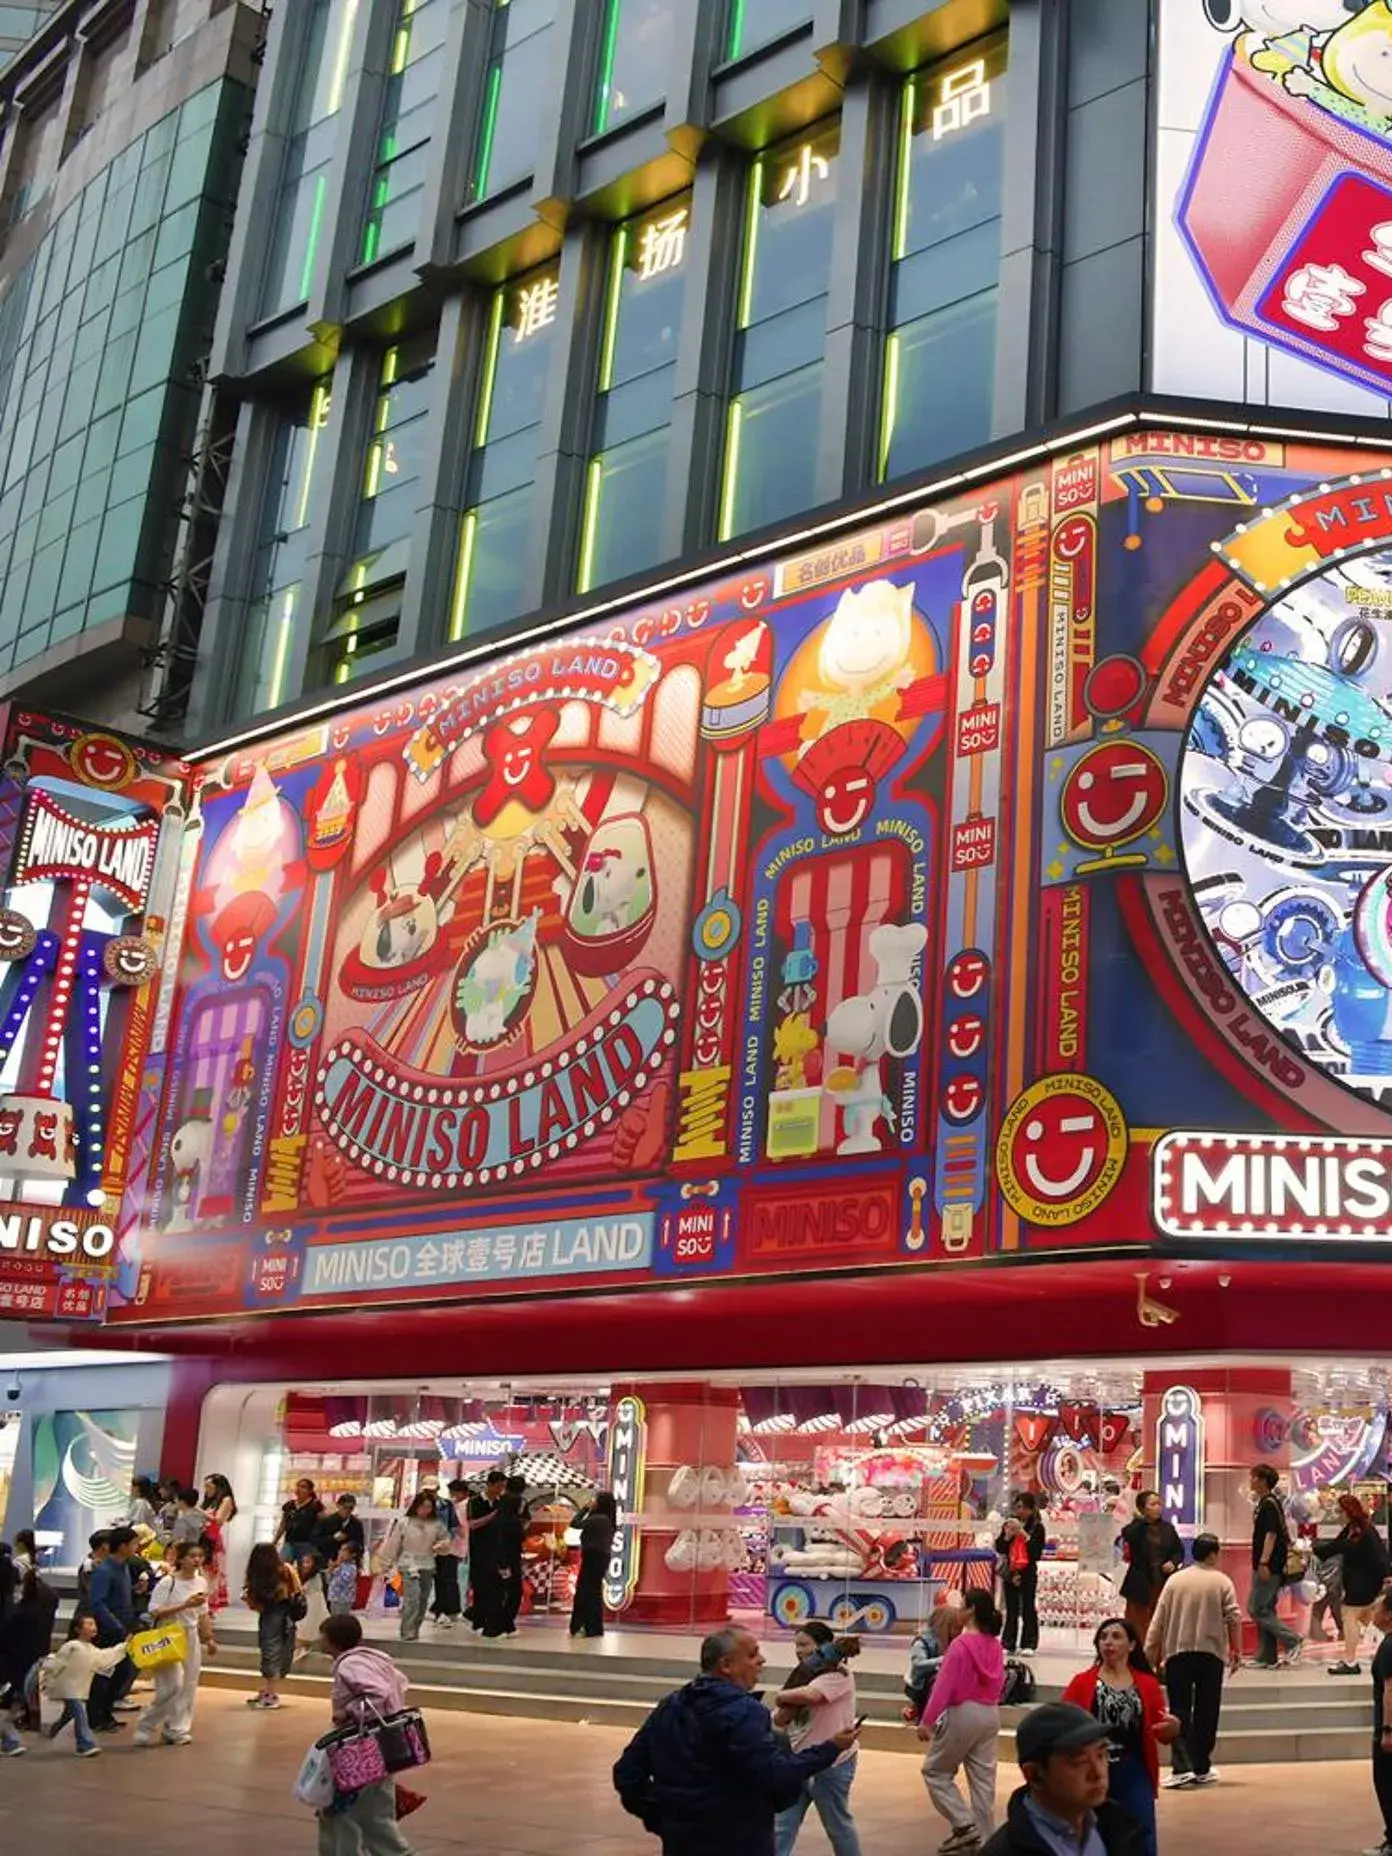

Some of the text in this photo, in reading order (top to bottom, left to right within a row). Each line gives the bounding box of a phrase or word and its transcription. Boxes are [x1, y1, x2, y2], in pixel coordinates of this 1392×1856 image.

[1057, 466, 1094, 486] MINI
[1125, 433, 1266, 461] MINISO
[1053, 611, 1066, 737] MINISO LAND
[1162, 601, 1243, 709] MINISO
[438, 655, 622, 736] MINISO LAND
[961, 711, 997, 731] MINI
[1232, 667, 1382, 761] MINISO
[28, 806, 150, 892] MINISO LAND
[765, 838, 815, 881] MINISO
[956, 824, 992, 845] MINI
[876, 819, 927, 915] MINISO LAND
[352, 974, 430, 1000] MINISO LAND
[749, 898, 771, 1023] MINISO LAND
[1059, 883, 1082, 1058] MINISO LAND
[1157, 889, 1307, 1090] MINISO LAND
[332, 1022, 644, 1173] MINISO LAND
[739, 1035, 760, 1164] MINISO LAND
[900, 1071, 916, 1143] MINISO
[1044, 1079, 1121, 1140] MINISO LAND
[1000, 1098, 1029, 1204] MINISO LAND
[242, 1167, 259, 1224] MINISO
[1073, 1157, 1118, 1215] MINISO
[314, 1221, 644, 1284] MINISO 全球壹号店 LAND
[678, 1214, 714, 1235] MINI
[755, 1194, 890, 1250] MINISO
[260, 1257, 288, 1274] MINI
[455, 1439, 513, 1456] MINISO
